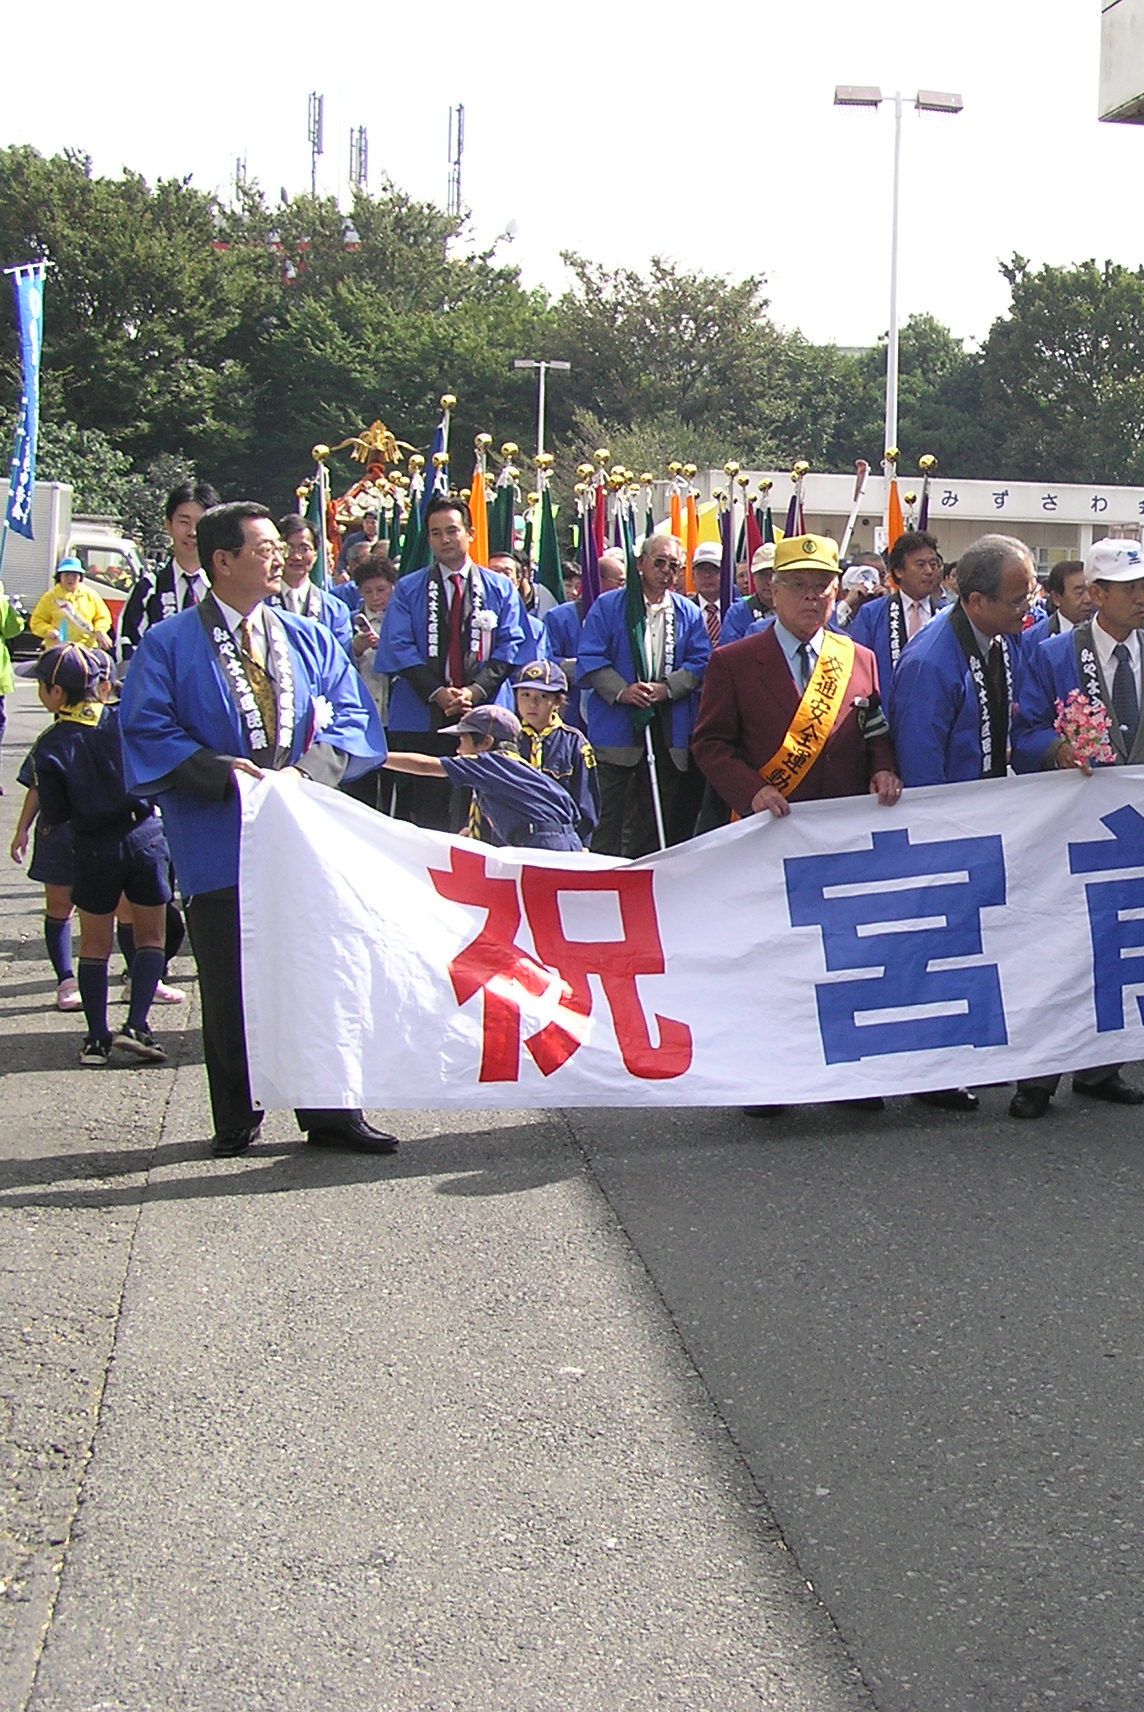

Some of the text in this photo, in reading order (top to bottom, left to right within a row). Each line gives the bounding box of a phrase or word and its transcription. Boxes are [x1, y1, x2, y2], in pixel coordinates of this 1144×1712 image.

[213, 616, 268, 749] みやまえ区民祭
[890, 602, 900, 669] みやまえ区民
[766, 655, 843, 792] 交通安全運動
[969, 655, 992, 772] みやまえ区民祭
